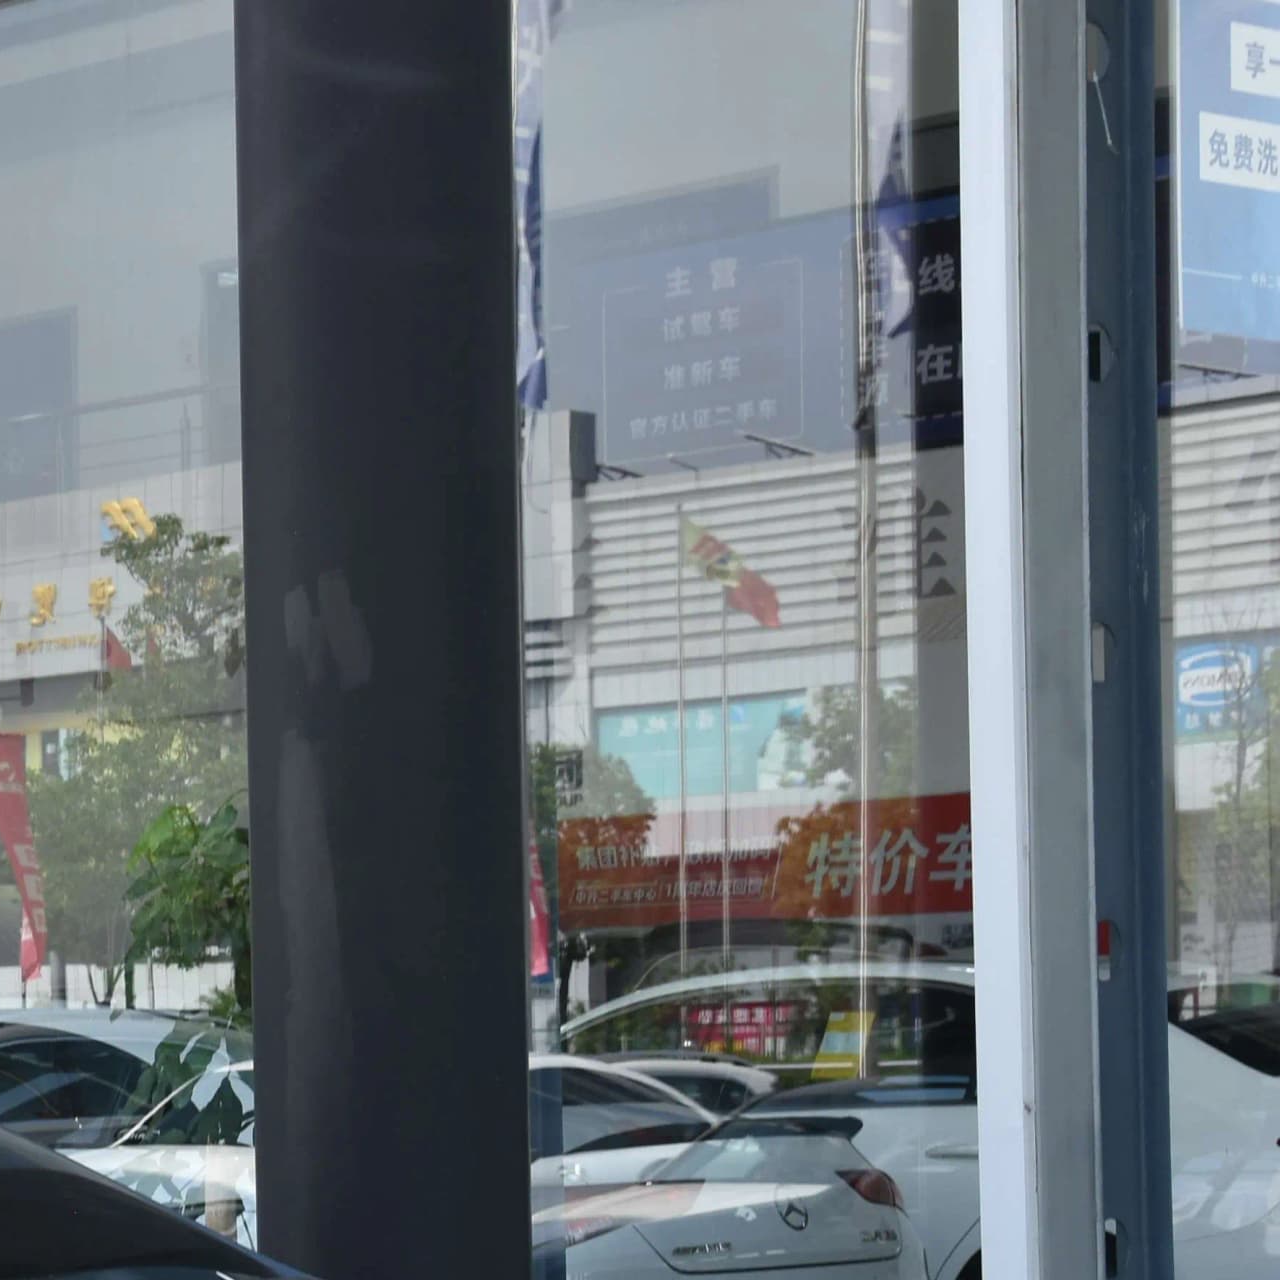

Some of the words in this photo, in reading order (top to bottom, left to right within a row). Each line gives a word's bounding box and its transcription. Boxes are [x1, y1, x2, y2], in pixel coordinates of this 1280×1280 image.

[1207, 128, 1279, 177] 免费洗
[663, 355, 742, 391] 准新车
[916, 343, 962, 386] 在
[629, 398, 778, 441] 官方认证二手车
[804, 823, 972, 899] 特价车
